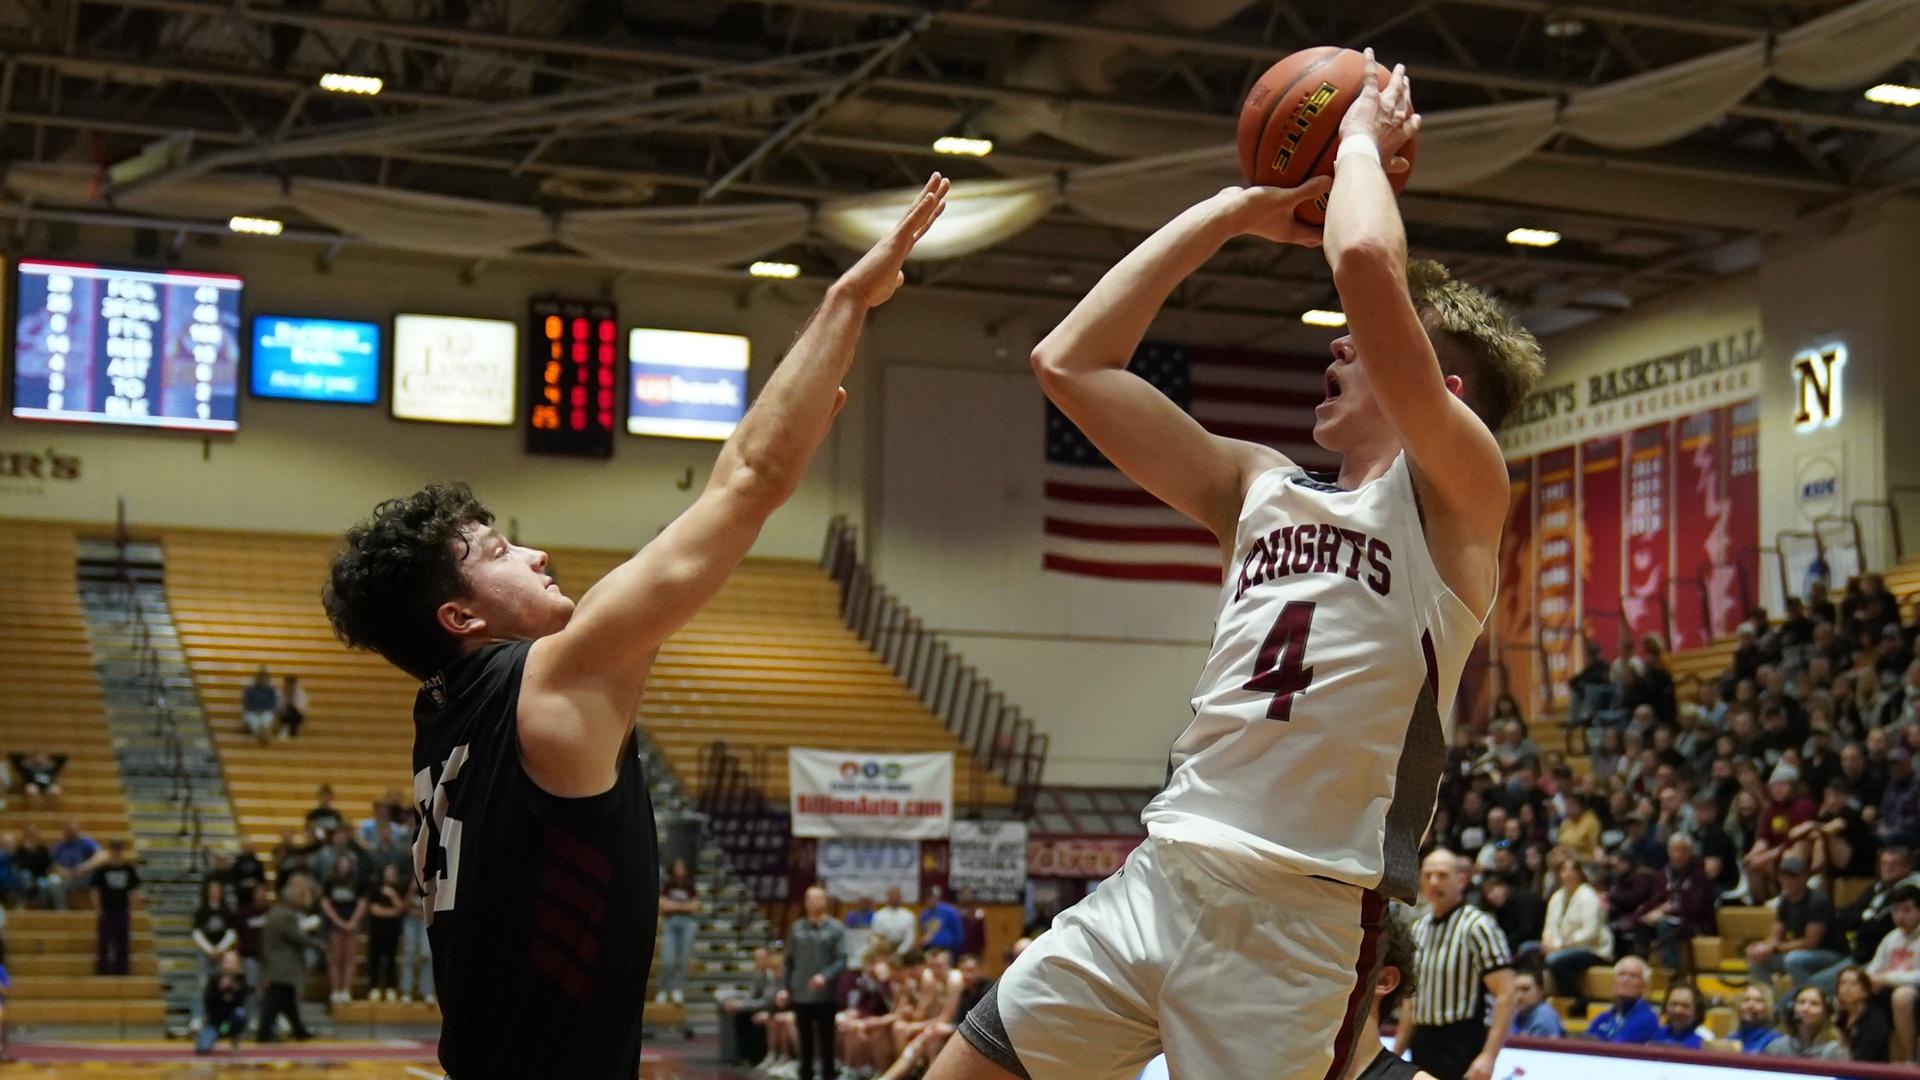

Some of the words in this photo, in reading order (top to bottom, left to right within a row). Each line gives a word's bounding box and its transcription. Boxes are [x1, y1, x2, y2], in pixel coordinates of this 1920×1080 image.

[1272, 80, 1339, 176] ELITE
[1588, 331, 1760, 405] BASKETBALL
[1793, 348, 1841, 425] N
[1234, 523, 1392, 603] KNIGHTS
[1242, 600, 1317, 722] 4
[796, 793, 944, 817] BillionAuto.com
